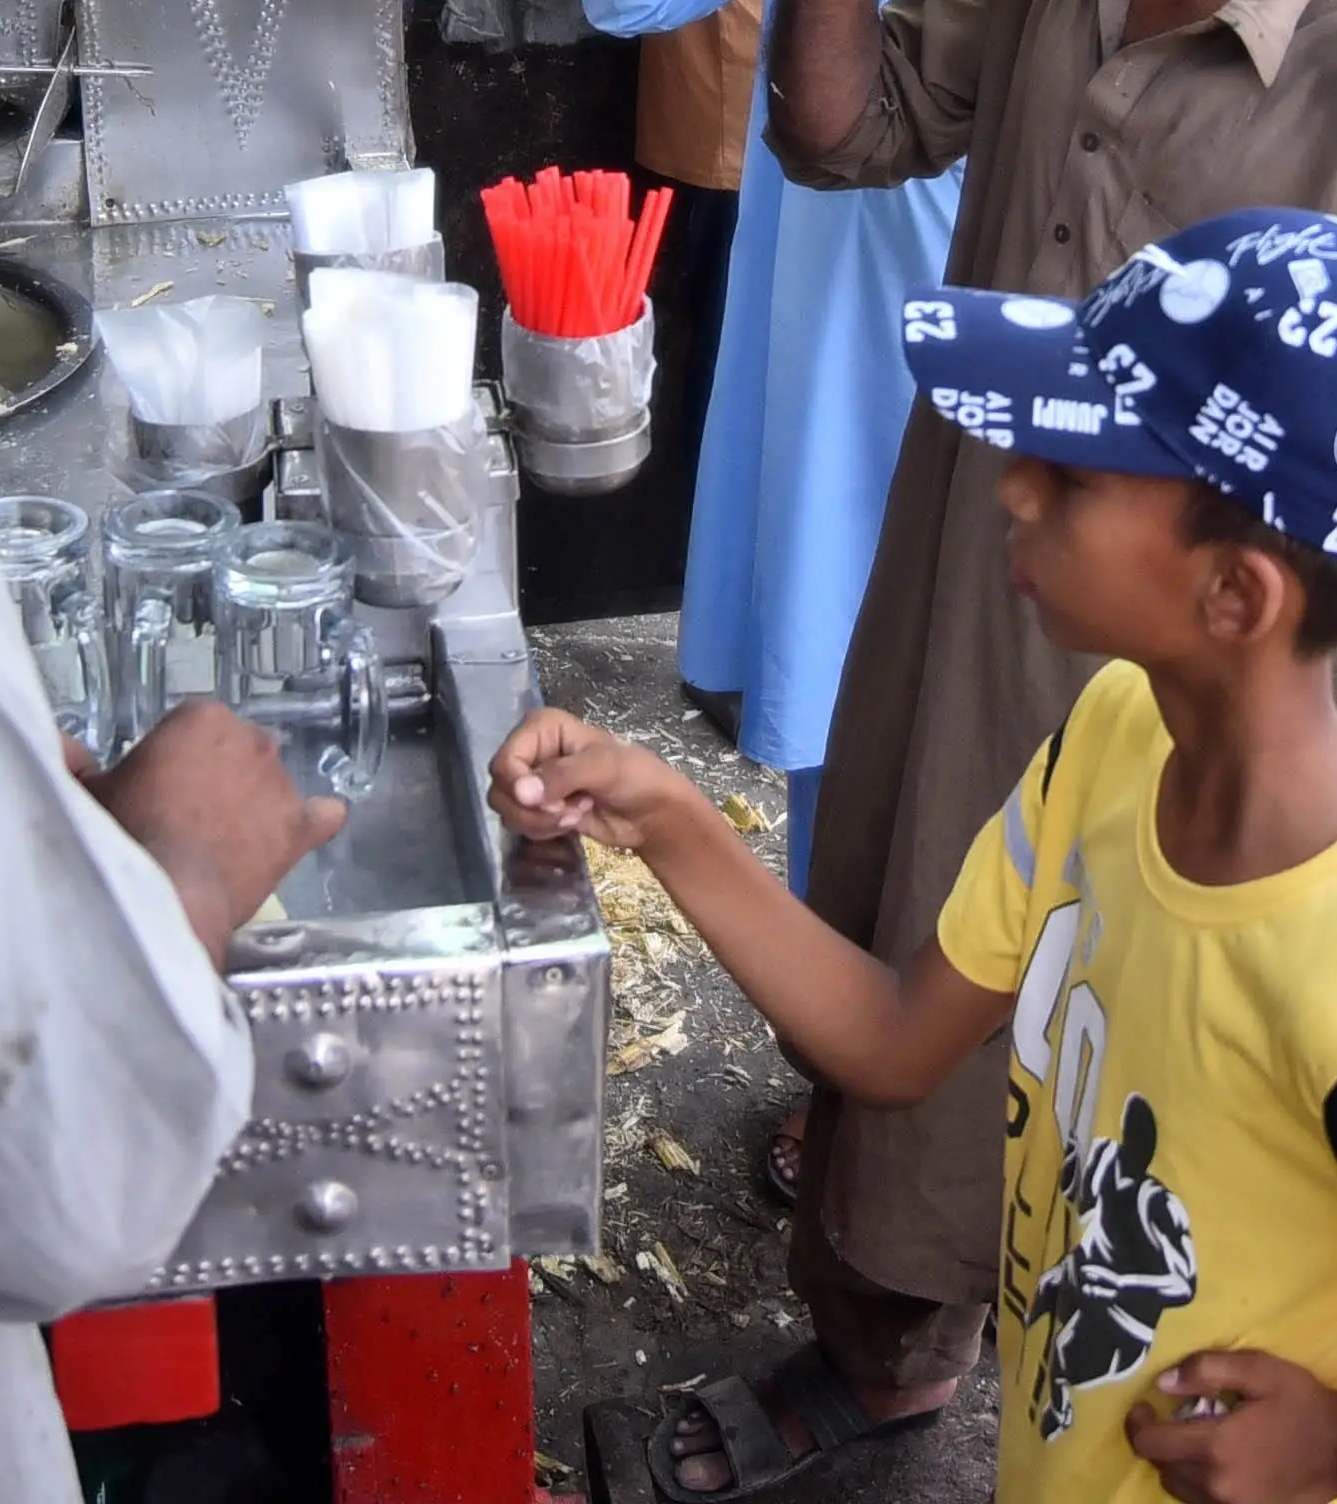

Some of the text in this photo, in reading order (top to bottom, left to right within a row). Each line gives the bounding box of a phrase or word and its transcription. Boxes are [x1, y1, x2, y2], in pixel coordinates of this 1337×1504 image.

[903, 300, 958, 344] 23
[1188, 382, 1240, 448] DAN
[1210, 400, 1262, 459] JOR
[1235, 413, 1286, 473] AIR
